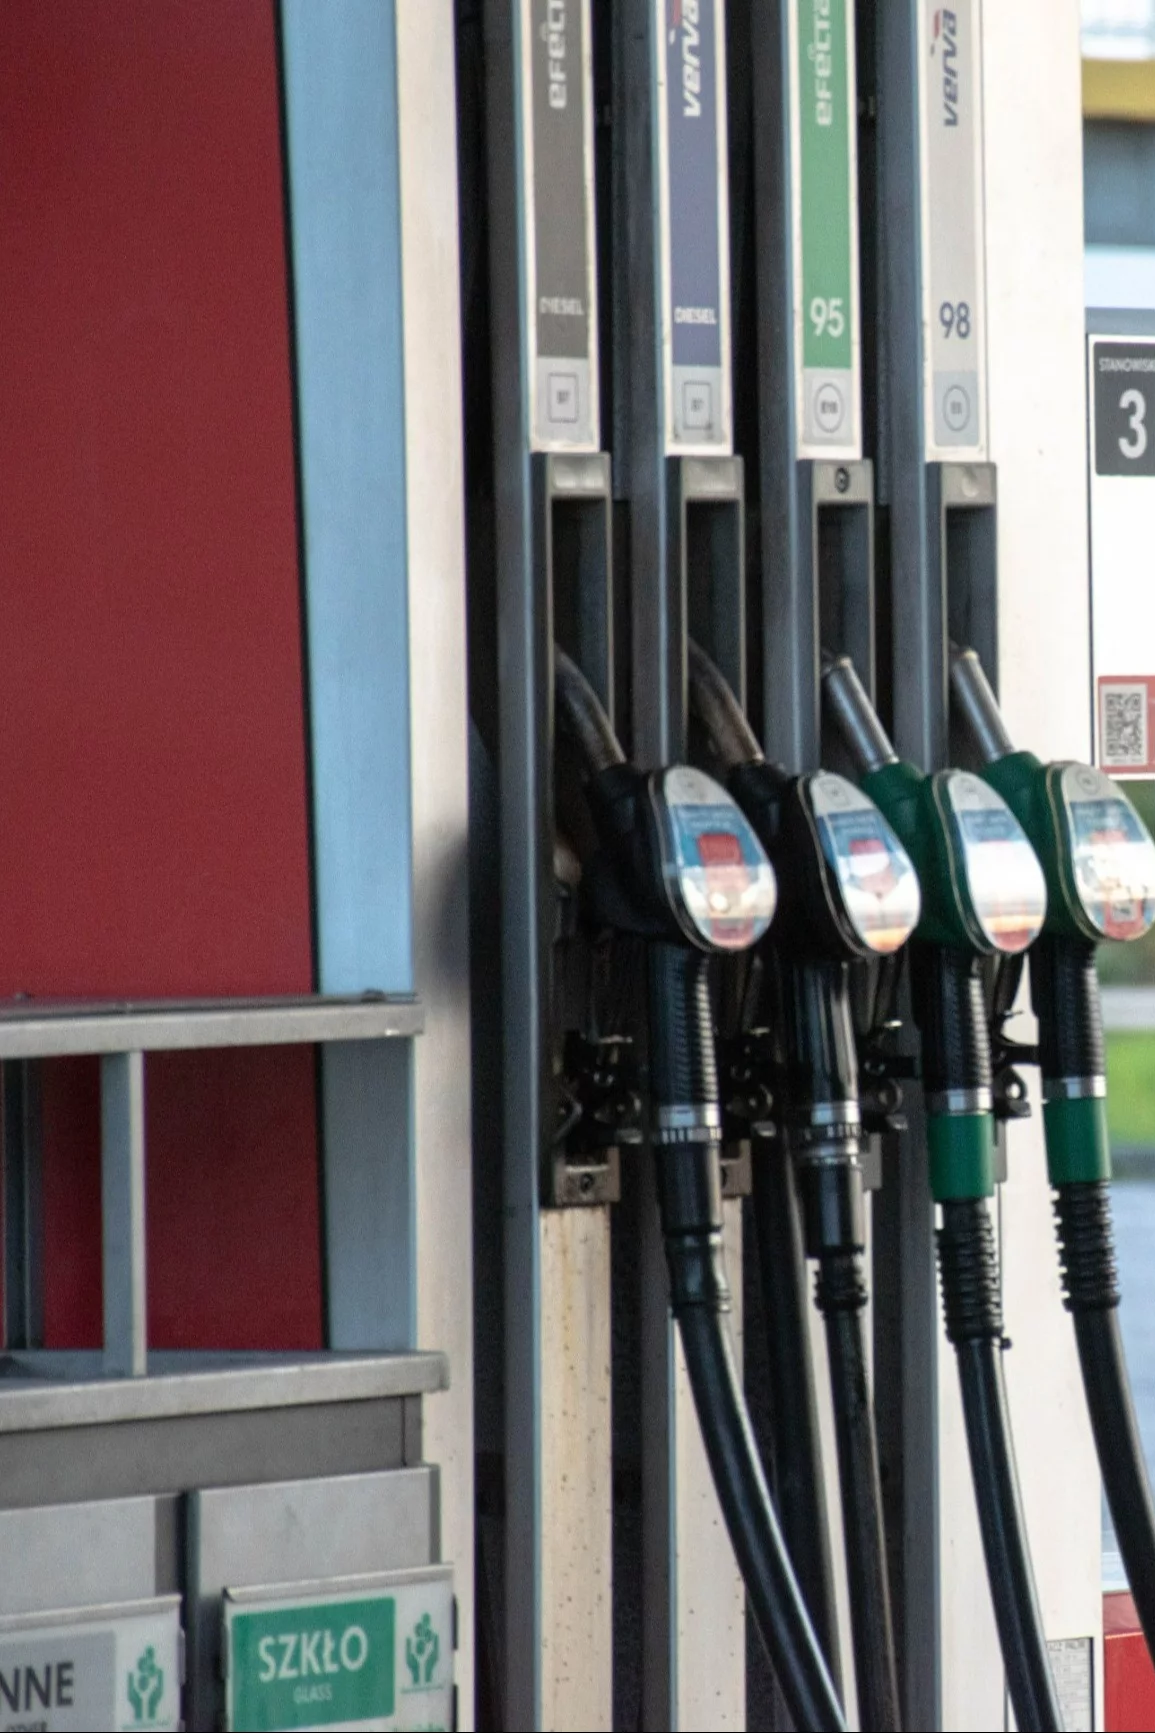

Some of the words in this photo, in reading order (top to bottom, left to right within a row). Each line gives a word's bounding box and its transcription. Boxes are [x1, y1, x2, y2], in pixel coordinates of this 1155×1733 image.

[681, 0, 701, 116] verva
[942, 9, 958, 126] verva
[539, 297, 584, 315] DIESEL
[674, 307, 716, 325] DIESEL
[810, 297, 844, 337] 95
[939, 302, 970, 339] 98
[1118, 389, 1147, 458] 3
[258, 1625, 368, 1682] SZKŁO
[293, 1683, 333, 1704] GLASS
